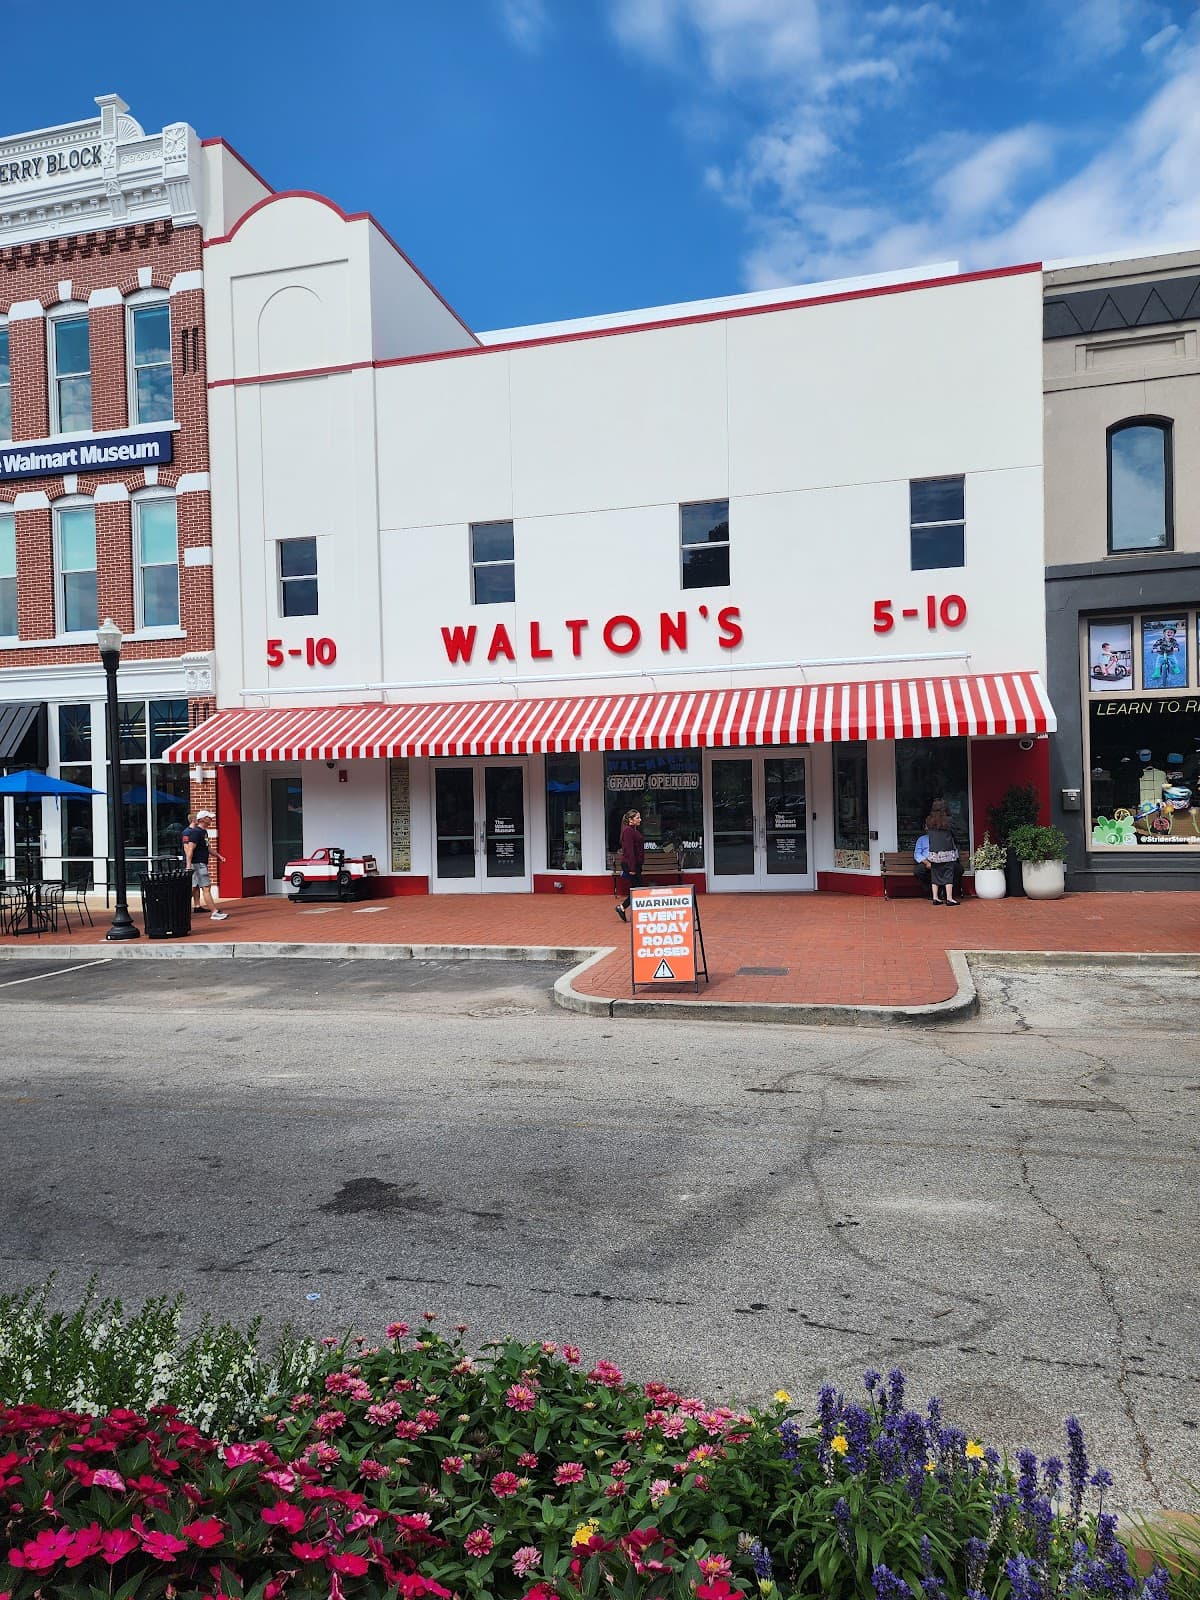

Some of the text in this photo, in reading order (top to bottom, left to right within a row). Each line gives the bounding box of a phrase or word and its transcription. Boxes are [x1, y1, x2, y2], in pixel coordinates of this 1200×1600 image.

[47, 145, 102, 174] BLOCK
[3, 449, 78, 473] Walmart
[80, 441, 160, 464] Museum
[873, 594, 967, 633] 5-10
[440, 605, 744, 664] WALTON'S
[266, 637, 337, 668] 5-10
[1096, 702, 1153, 716] LEARN
[1157, 700, 1180, 713] TO
[609, 774, 698, 789] GRAND OPENING
[635, 897, 690, 908] WARNING
[638, 909, 687, 922] EVENT
[636, 921, 690, 934] TODAY
[642, 934, 684, 946] ROAD
[637, 946, 690, 958] CLOSED
